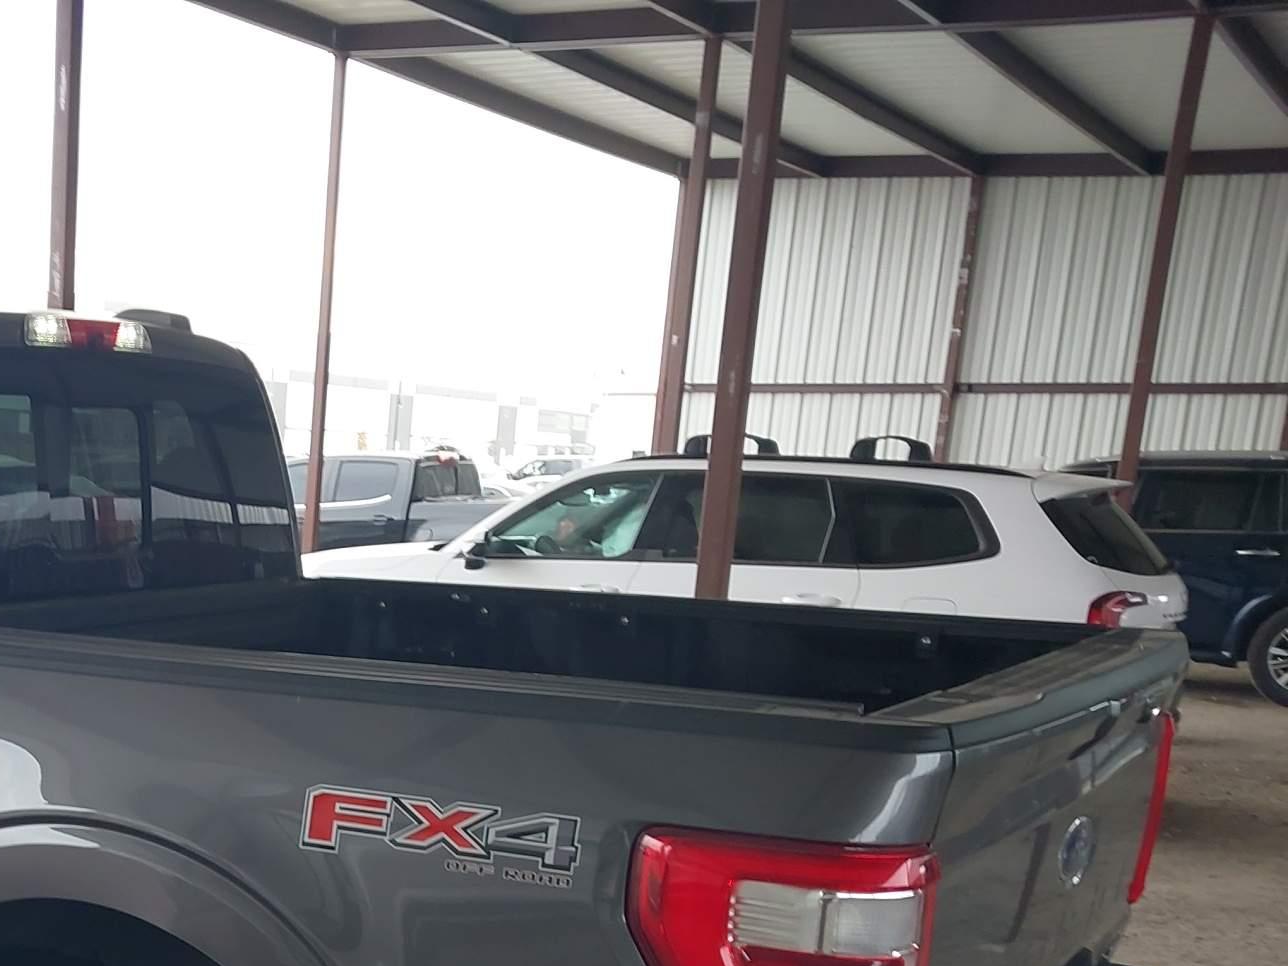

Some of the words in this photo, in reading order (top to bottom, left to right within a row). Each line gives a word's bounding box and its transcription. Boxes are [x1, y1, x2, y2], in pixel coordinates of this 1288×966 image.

[300, 784, 581, 874] FX4
[445, 860, 494, 875] OFF
[502, 867, 572, 888] ROAD
